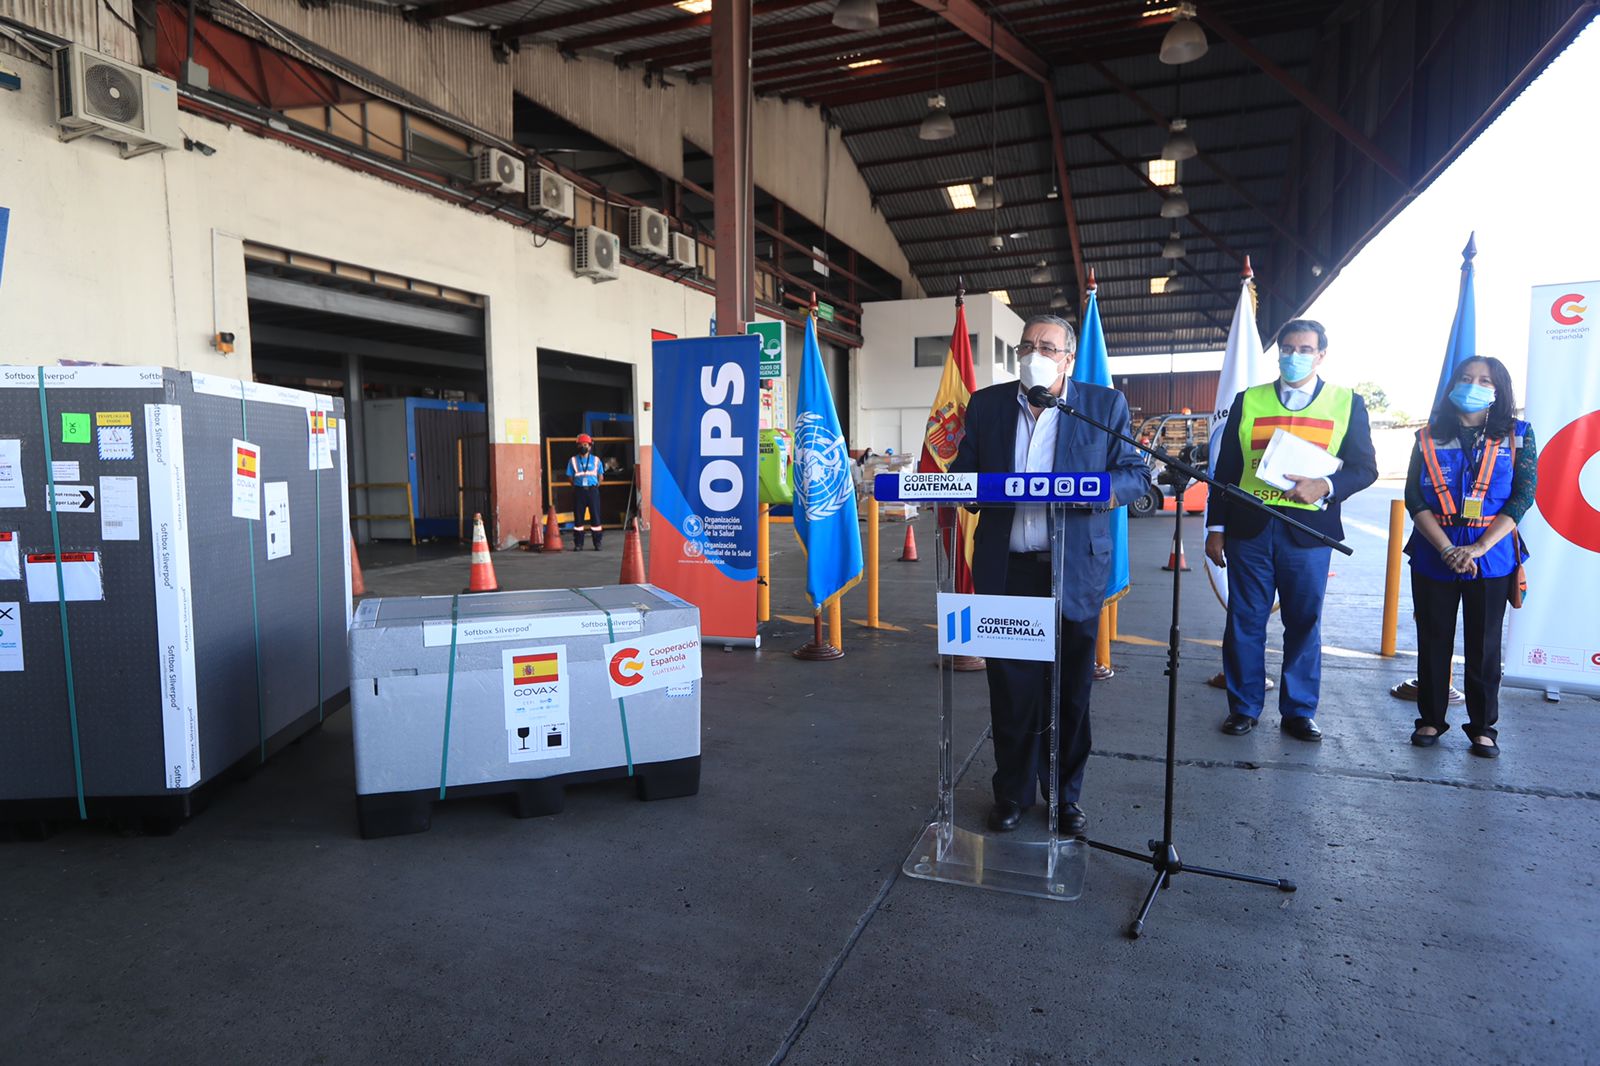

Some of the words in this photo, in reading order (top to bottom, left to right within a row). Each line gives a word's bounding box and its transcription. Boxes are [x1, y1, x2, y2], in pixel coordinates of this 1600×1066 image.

[4, 372, 35, 380] Softbox
[69, 422, 77, 434] OK
[698, 361, 745, 512] OPS
[904, 474, 955, 482] GOBIERNO
[903, 482, 973, 492] GUATEMALA
[704, 516, 740, 524] Organización
[980, 617, 1030, 627] GOBIERNO
[977, 625, 1045, 636] GUATEMALA
[649, 640, 698, 656] Cooperación
[651, 653, 686, 667] Española
[652, 664, 686, 676] GUATEMALA
[514, 686, 558, 697] COVAX
